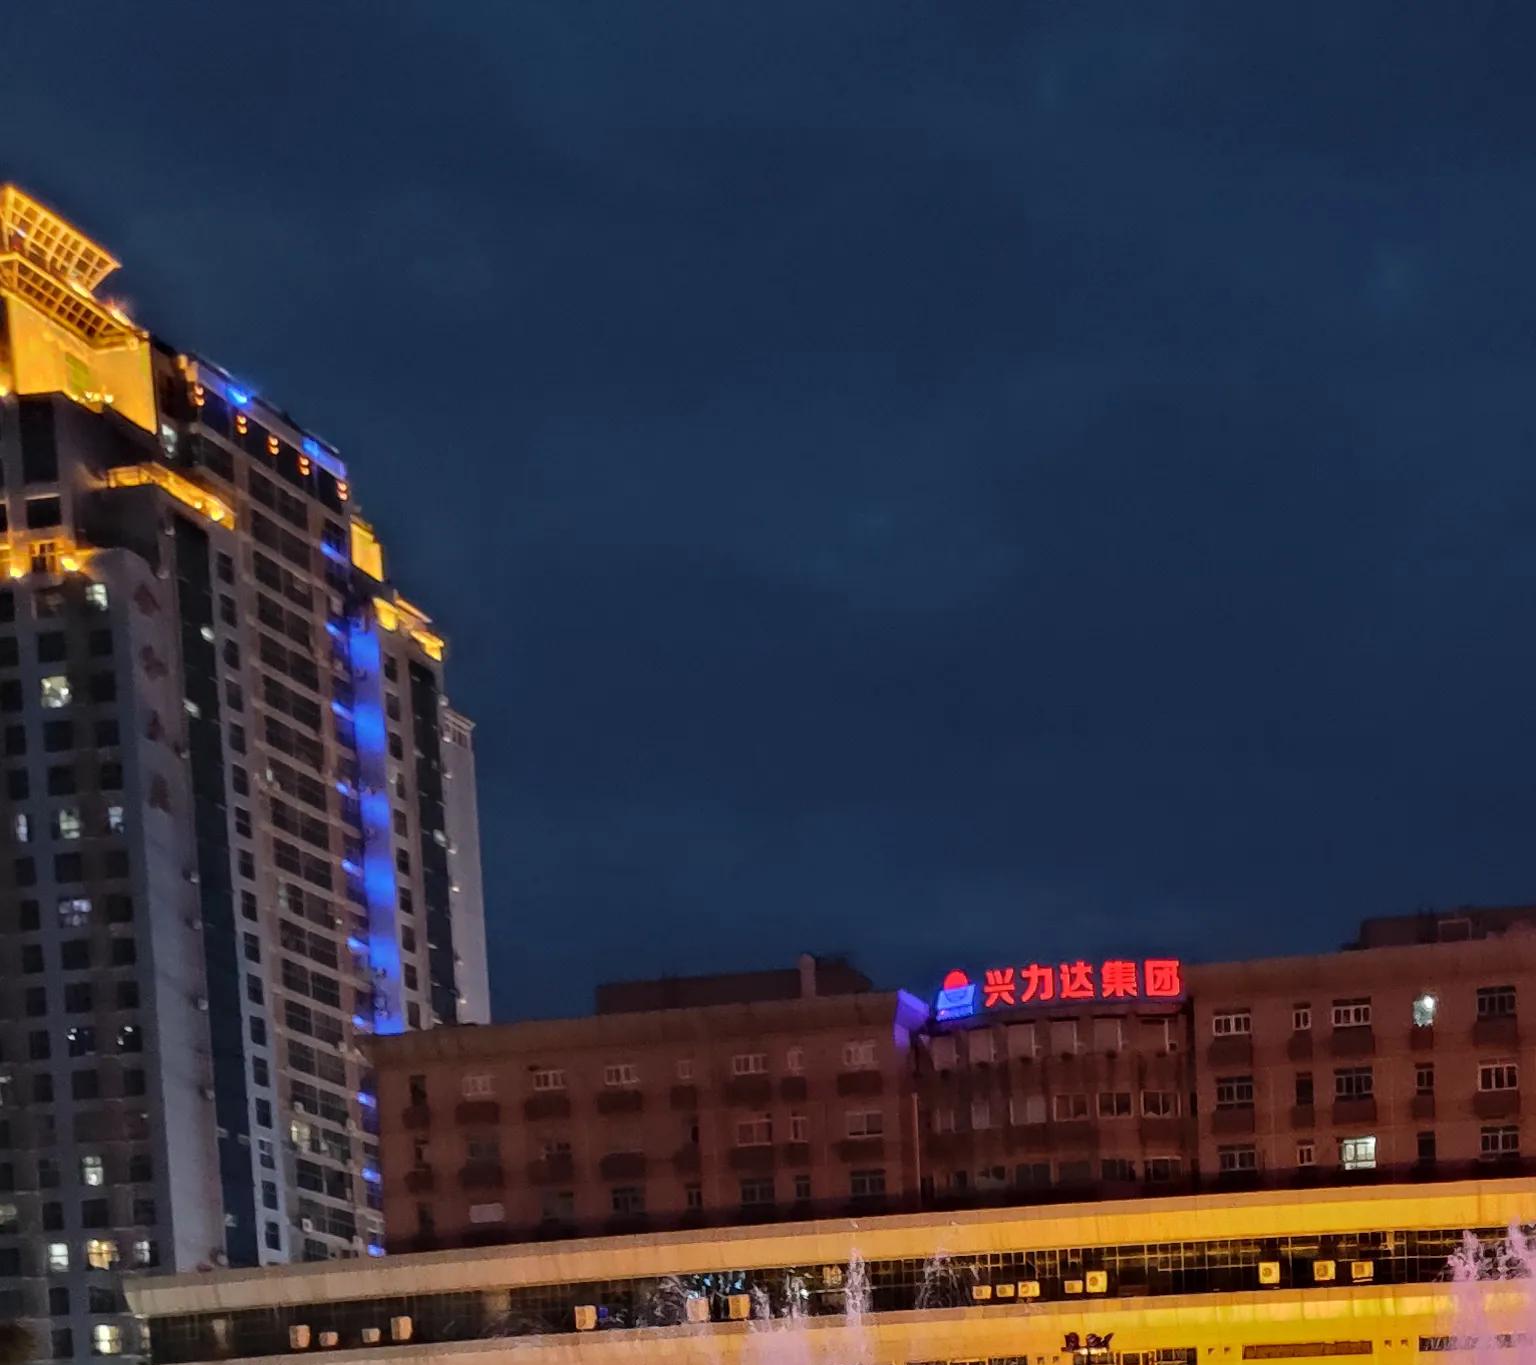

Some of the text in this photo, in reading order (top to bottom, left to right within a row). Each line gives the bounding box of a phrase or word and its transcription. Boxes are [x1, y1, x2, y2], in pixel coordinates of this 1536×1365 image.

[983, 959, 1181, 1008] 兴力达集团
